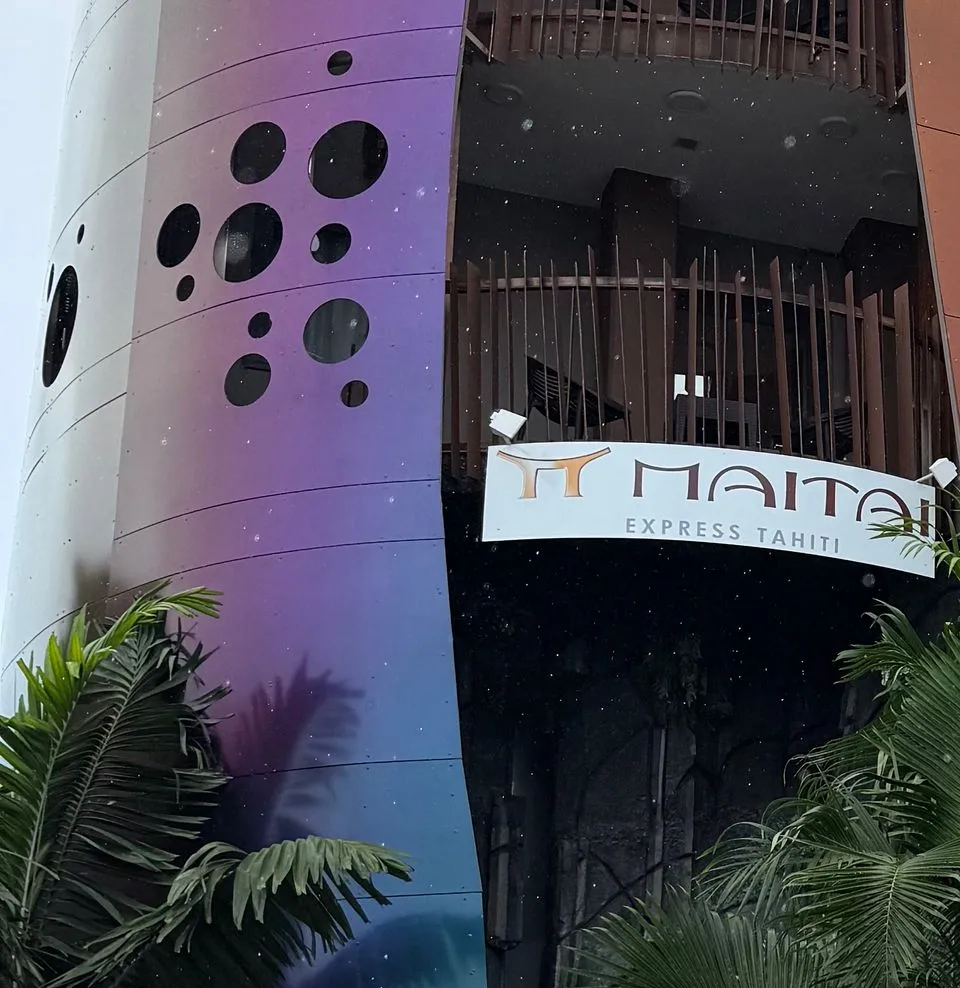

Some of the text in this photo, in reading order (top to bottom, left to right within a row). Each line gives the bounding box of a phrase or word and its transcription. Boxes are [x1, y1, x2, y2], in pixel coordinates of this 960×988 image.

[633, 458, 930, 537] MAITAI
[625, 516, 841, 555] EXPRESS TAHITI
